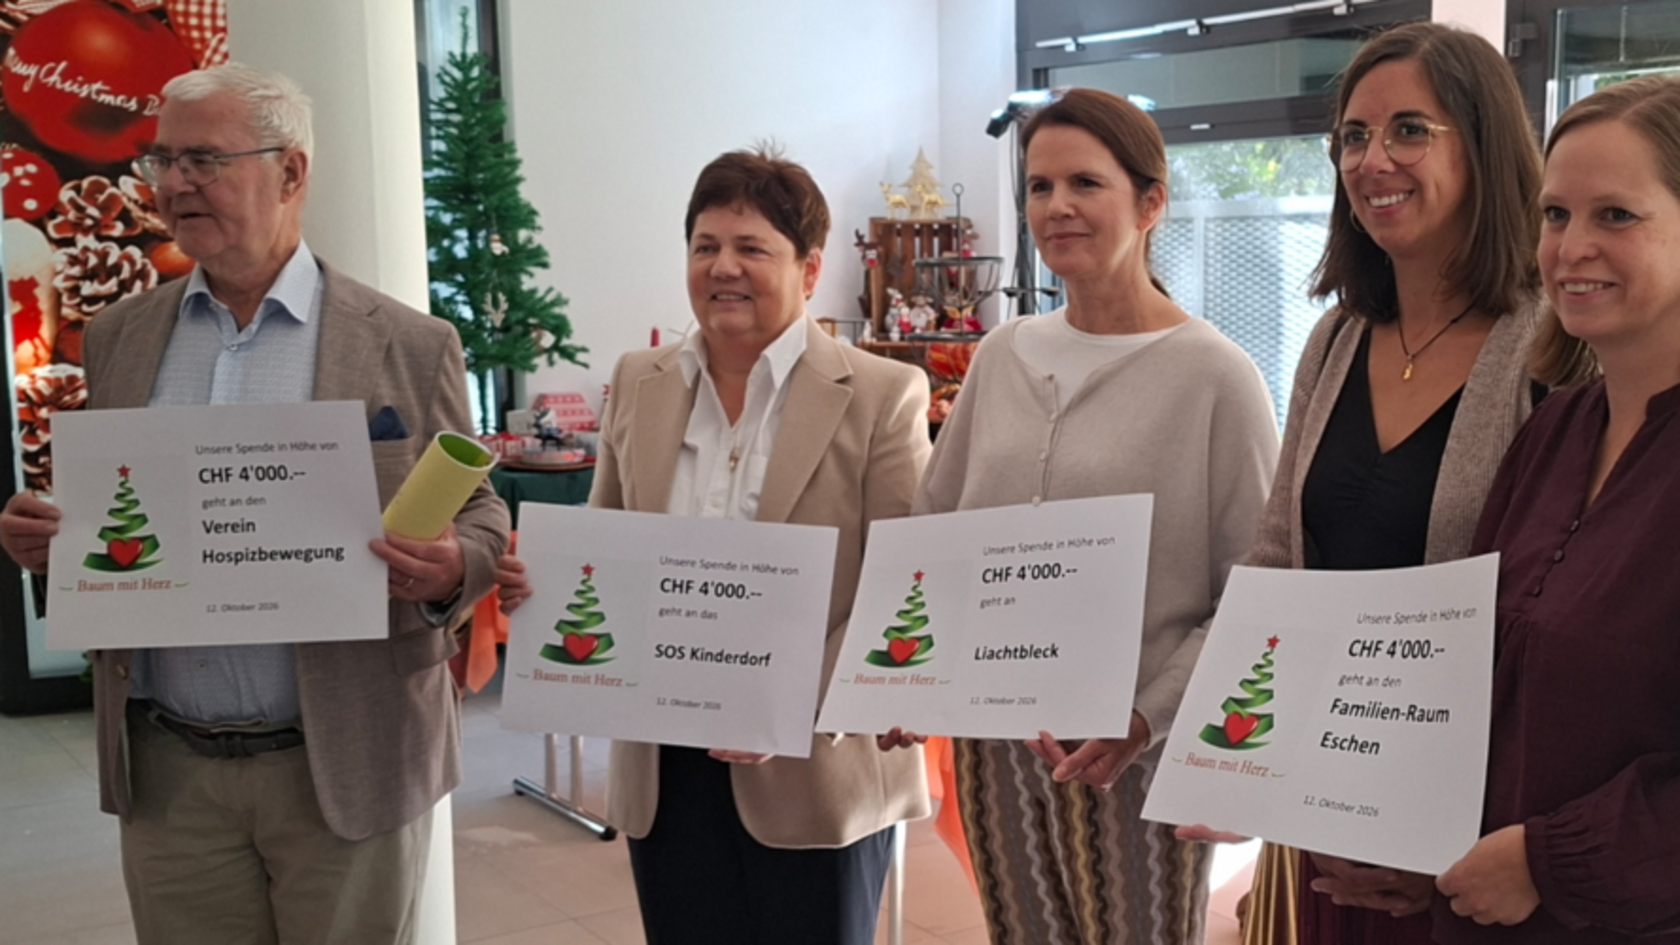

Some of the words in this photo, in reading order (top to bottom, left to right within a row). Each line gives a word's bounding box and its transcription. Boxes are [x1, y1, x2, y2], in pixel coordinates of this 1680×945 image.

[39, 60, 138, 112] Christmas
[194, 445, 234, 456] Unsere
[235, 442, 275, 455] Spende
[277, 442, 288, 452] in
[288, 440, 318, 452] Höhe
[318, 441, 339, 451] von
[197, 466, 234, 485] CHF
[238, 464, 307, 483] 4'000.--
[201, 496, 227, 511] geht
[228, 497, 243, 507] an
[244, 495, 267, 507] den
[201, 517, 257, 535] Verein
[201, 546, 345, 566] Hospizbewegung
[982, 545, 1016, 557] Unsere
[1017, 540, 1054, 555] Spende
[1055, 540, 1066, 550] in
[1067, 537, 1095, 549] Höhe
[1095, 536, 1116, 547] von
[659, 555, 698, 568] Unsere
[699, 558, 738, 572] Spende
[739, 562, 750, 572] in
[751, 563, 779, 575] Höhe
[779, 567, 800, 576] von
[981, 565, 1013, 585] CHF
[1016, 562, 1078, 581] 4'000.--
[76, 579, 115, 593] Baum
[116, 579, 139, 591] mit
[140, 577, 172, 591] Herz
[659, 577, 695, 595] CHF
[698, 580, 763, 600] 4'000.--
[220, 603, 256, 613] Oktober
[979, 596, 1003, 610] geht
[1003, 596, 1016, 606] an
[657, 606, 683, 618] geht
[684, 609, 698, 618] an
[699, 609, 719, 621] das
[1356, 613, 1393, 625] Unsere
[1392, 610, 1429, 626] Spende
[1429, 610, 1438, 622] in
[1439, 608, 1462, 621] Höhe
[1462, 607, 1477, 619] von
[654, 643, 686, 661] SOS
[689, 646, 772, 668] Kinderdorf
[974, 642, 1059, 661] Liachtbleck
[1348, 638, 1385, 659] CHF
[1385, 638, 1446, 660] 4'000.--
[532, 667, 569, 683] Baum
[570, 674, 592, 685] mit
[593, 673, 624, 688] Herz
[853, 672, 887, 686] Baum
[887, 673, 909, 686] mit
[909, 673, 937, 686] Herz
[1337, 673, 1365, 687] geht
[1365, 676, 1380, 687] an
[1381, 675, 1403, 688] den
[669, 698, 702, 709] Oktober
[983, 696, 1016, 706] Oktober
[1329, 697, 1451, 724] Familien-Raum
[1319, 730, 1381, 756] Eschen
[1184, 751, 1218, 770] Baum
[1217, 759, 1239, 773] mit
[1239, 759, 1270, 778] Herz
[1318, 797, 1356, 813] Oktober
